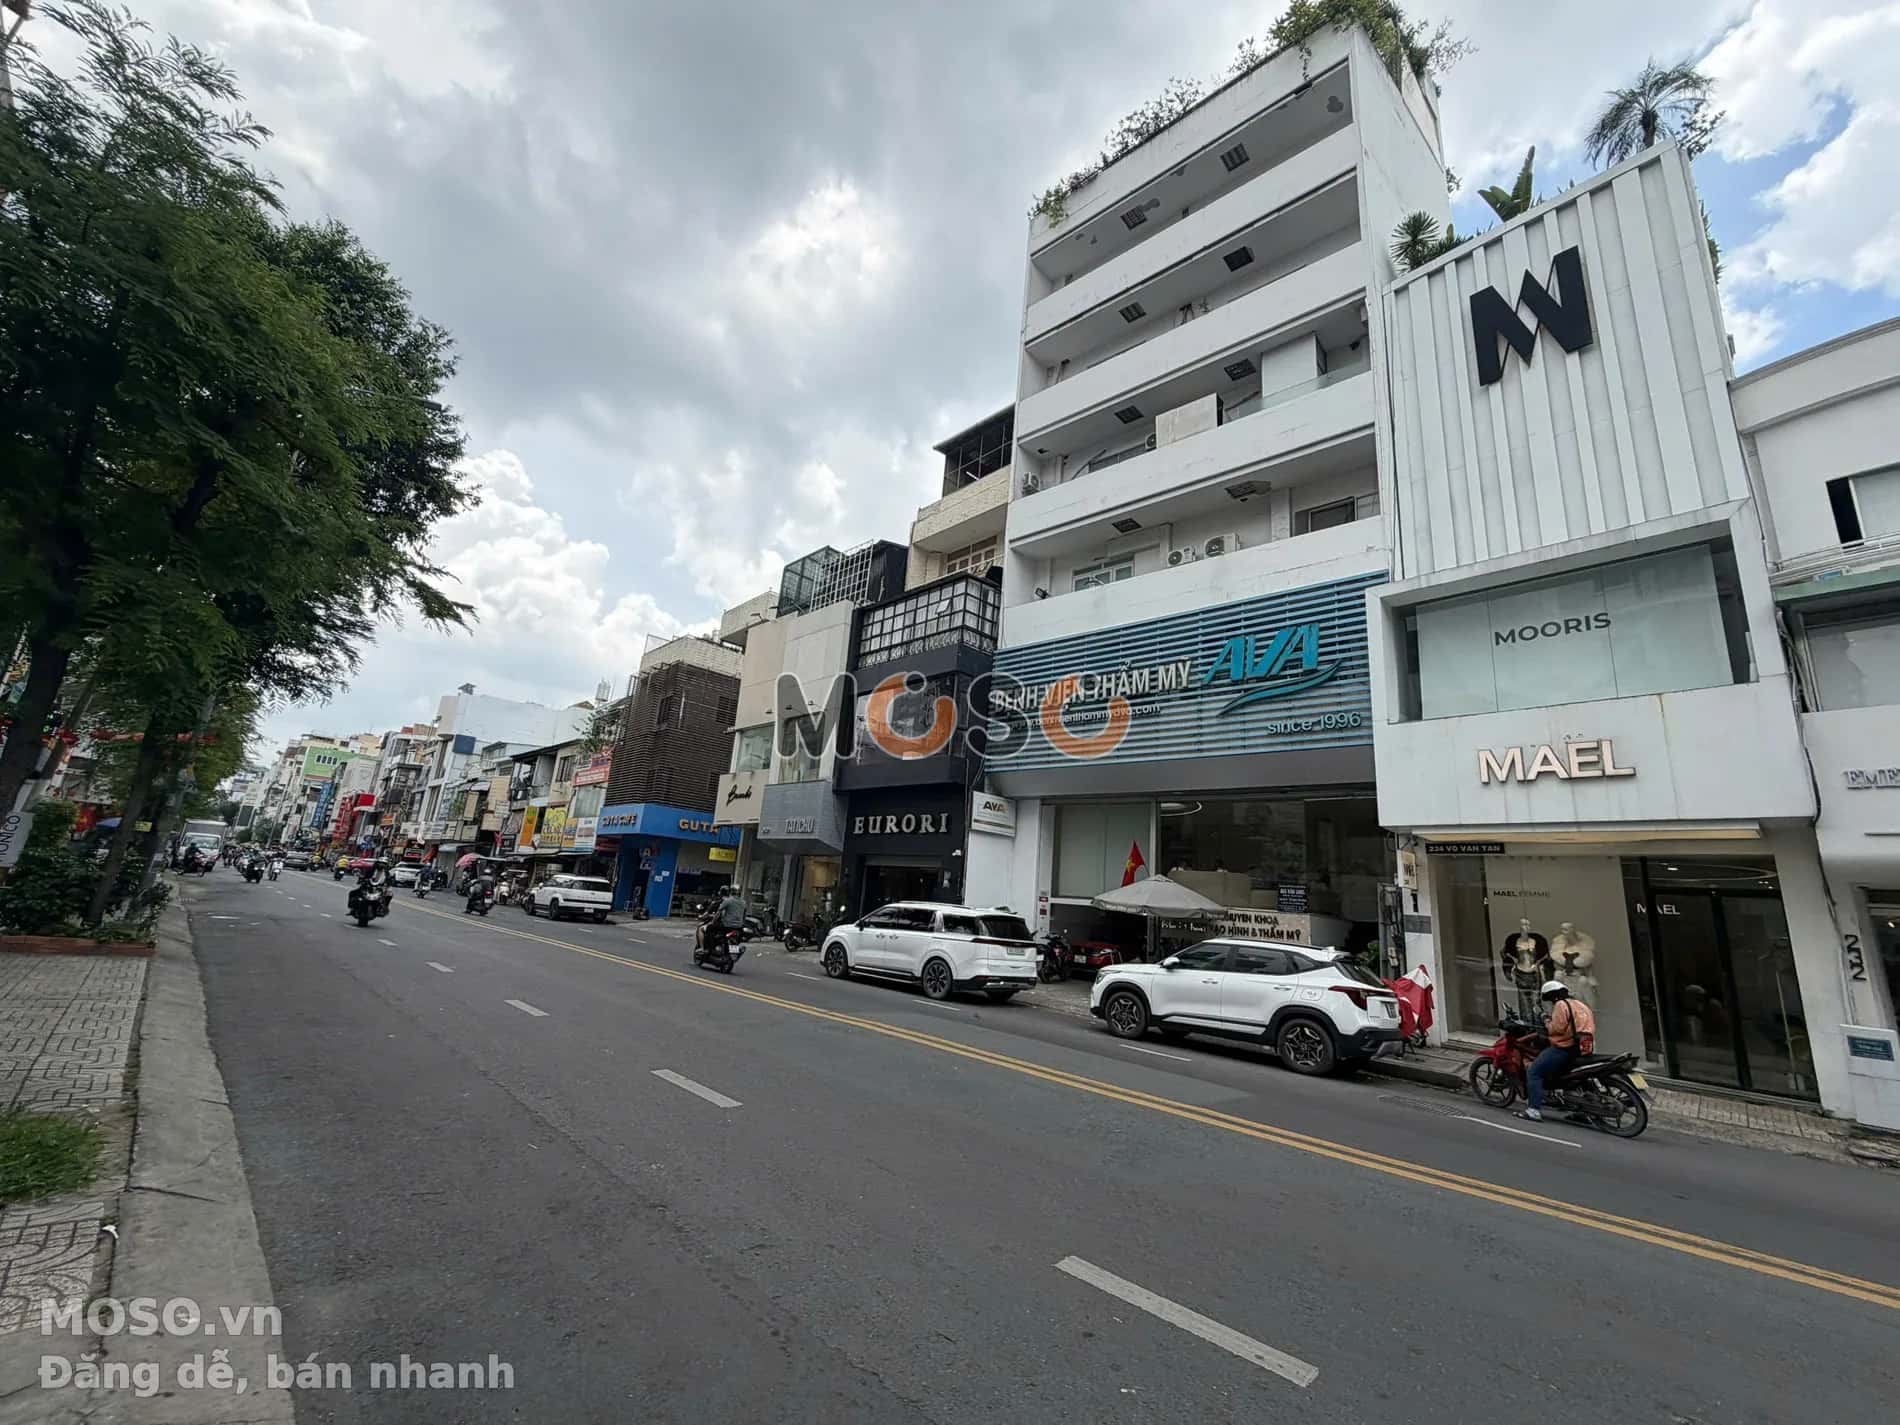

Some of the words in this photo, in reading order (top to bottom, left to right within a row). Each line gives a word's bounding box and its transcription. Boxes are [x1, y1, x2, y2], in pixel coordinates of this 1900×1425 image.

[1494, 612, 1612, 646] MOORIS
[1201, 622, 1320, 685] AVA
[1157, 656, 1192, 690] MỸ
[1267, 715, 1313, 736] since
[1318, 711, 1361, 730] 1996
[853, 812, 949, 834] EURORI
[1844, 933, 1867, 981] 232
